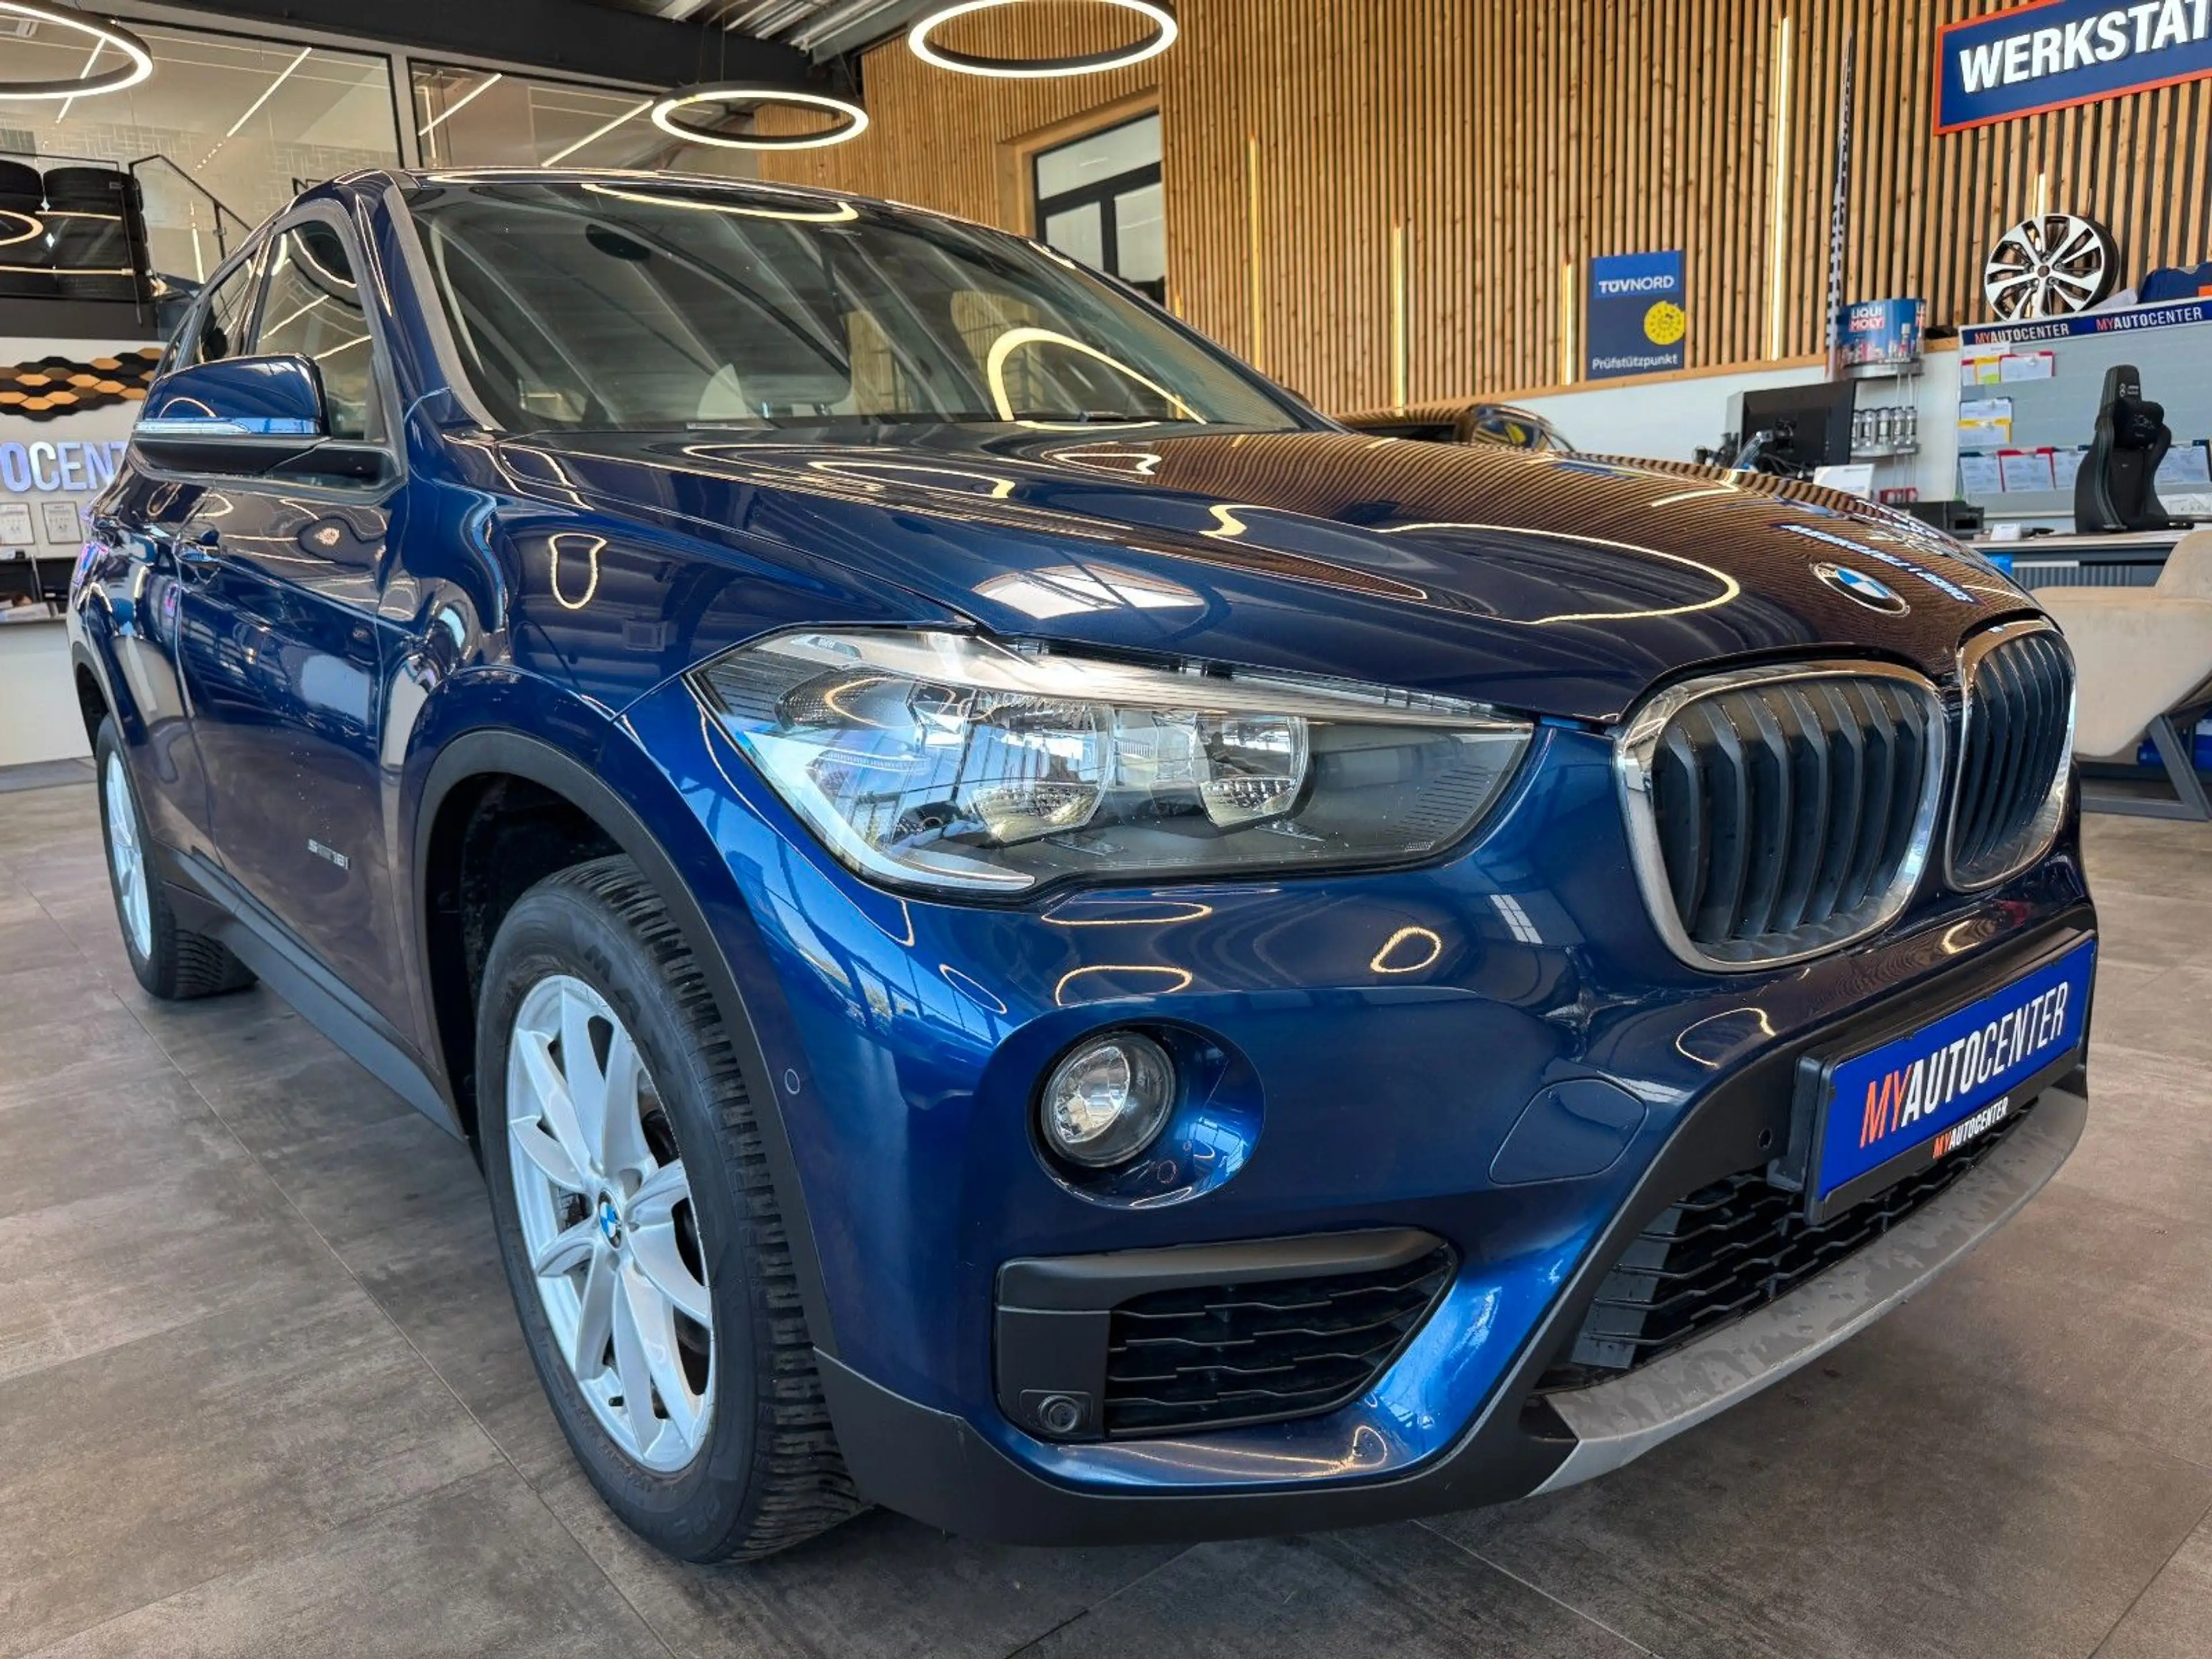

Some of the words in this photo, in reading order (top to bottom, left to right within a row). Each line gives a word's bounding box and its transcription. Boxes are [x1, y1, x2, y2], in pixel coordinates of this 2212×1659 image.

[1851, 316, 1884, 331] MOLY
[2096, 306, 2202, 332] MYAUTOCENTER
[1974, 323, 2070, 344] MYAUTOCENTER
[1592, 353, 1678, 370] Prüfstützpunkt
[1859, 981, 2069, 1149] MYAUTOCENTER
[1933, 1096, 2009, 1160] MYAUTOCENTER
